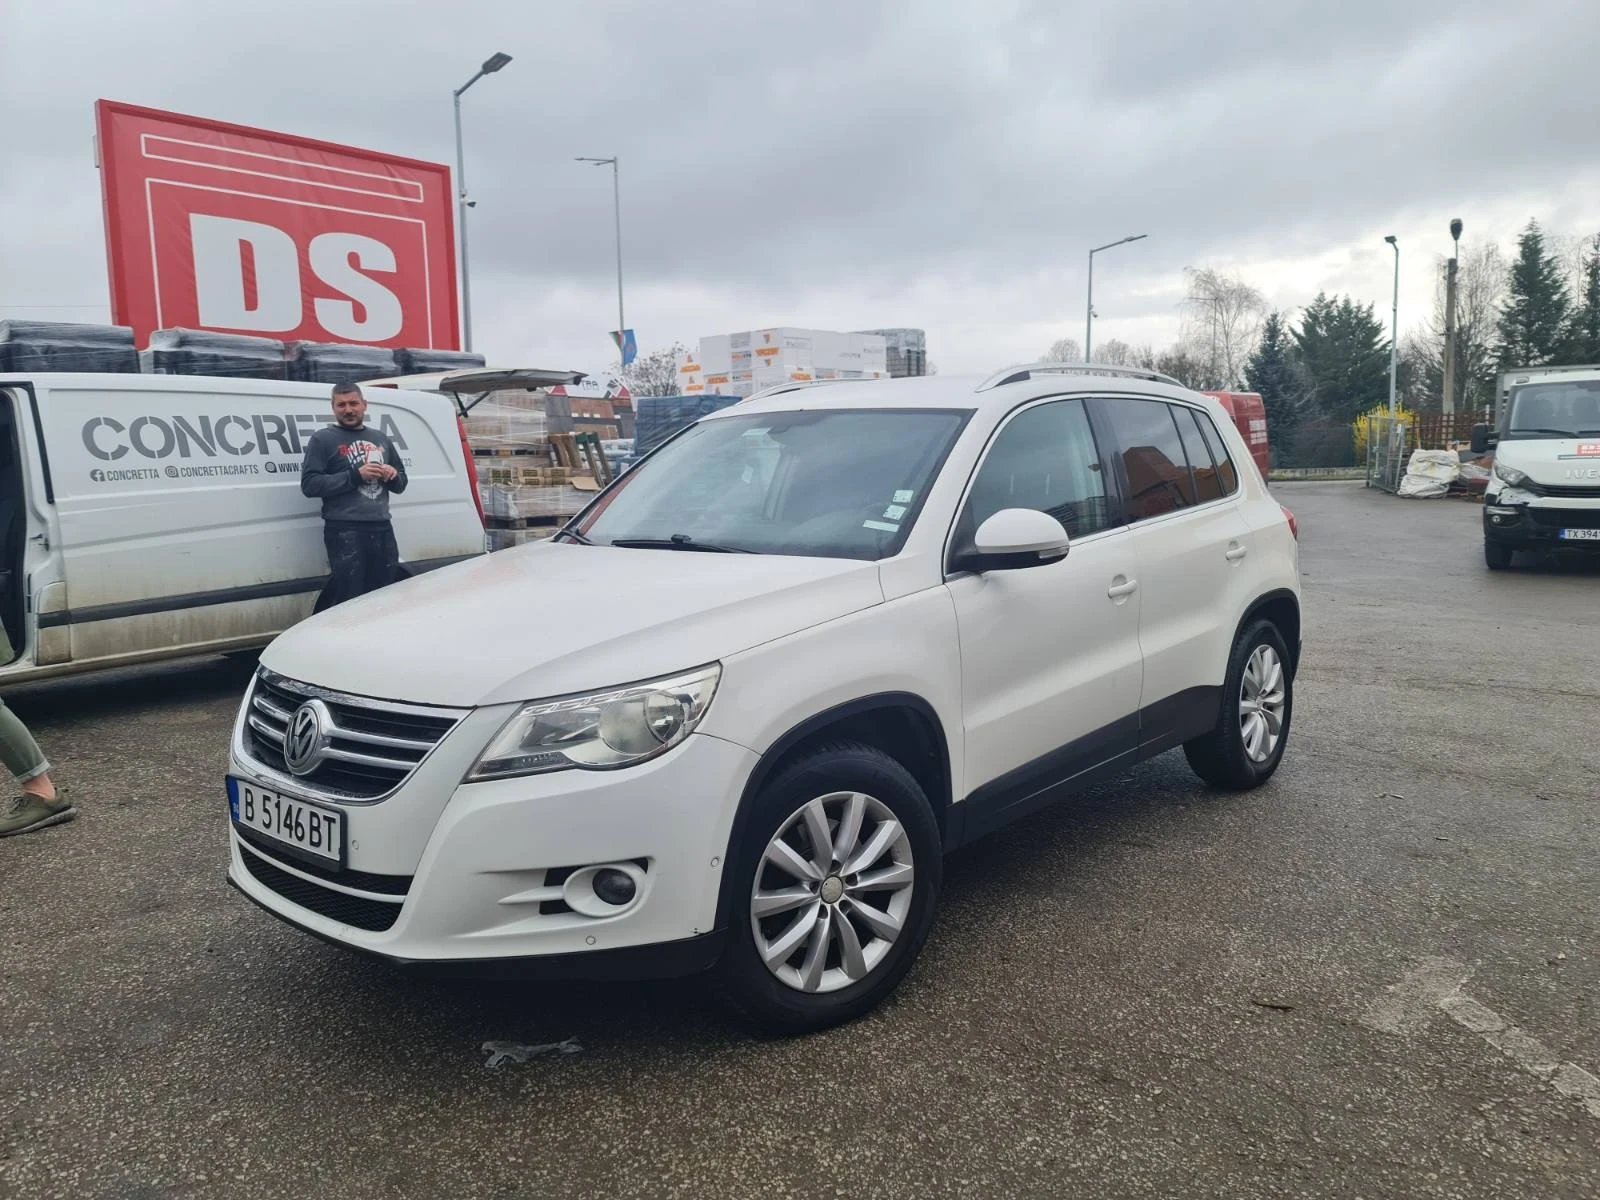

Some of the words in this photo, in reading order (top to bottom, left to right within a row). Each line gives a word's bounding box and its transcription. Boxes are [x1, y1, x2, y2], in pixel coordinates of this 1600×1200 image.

[189, 213, 403, 342] DS
[82, 413, 409, 461] CONCREA
[106, 468, 160, 481] CONCRETTA
[180, 464, 259, 478] CONCRETTACRAFTS
[1564, 469, 1600, 480] IVE
[1567, 529, 1578, 538] TX
[1580, 530, 1600, 539] 394
